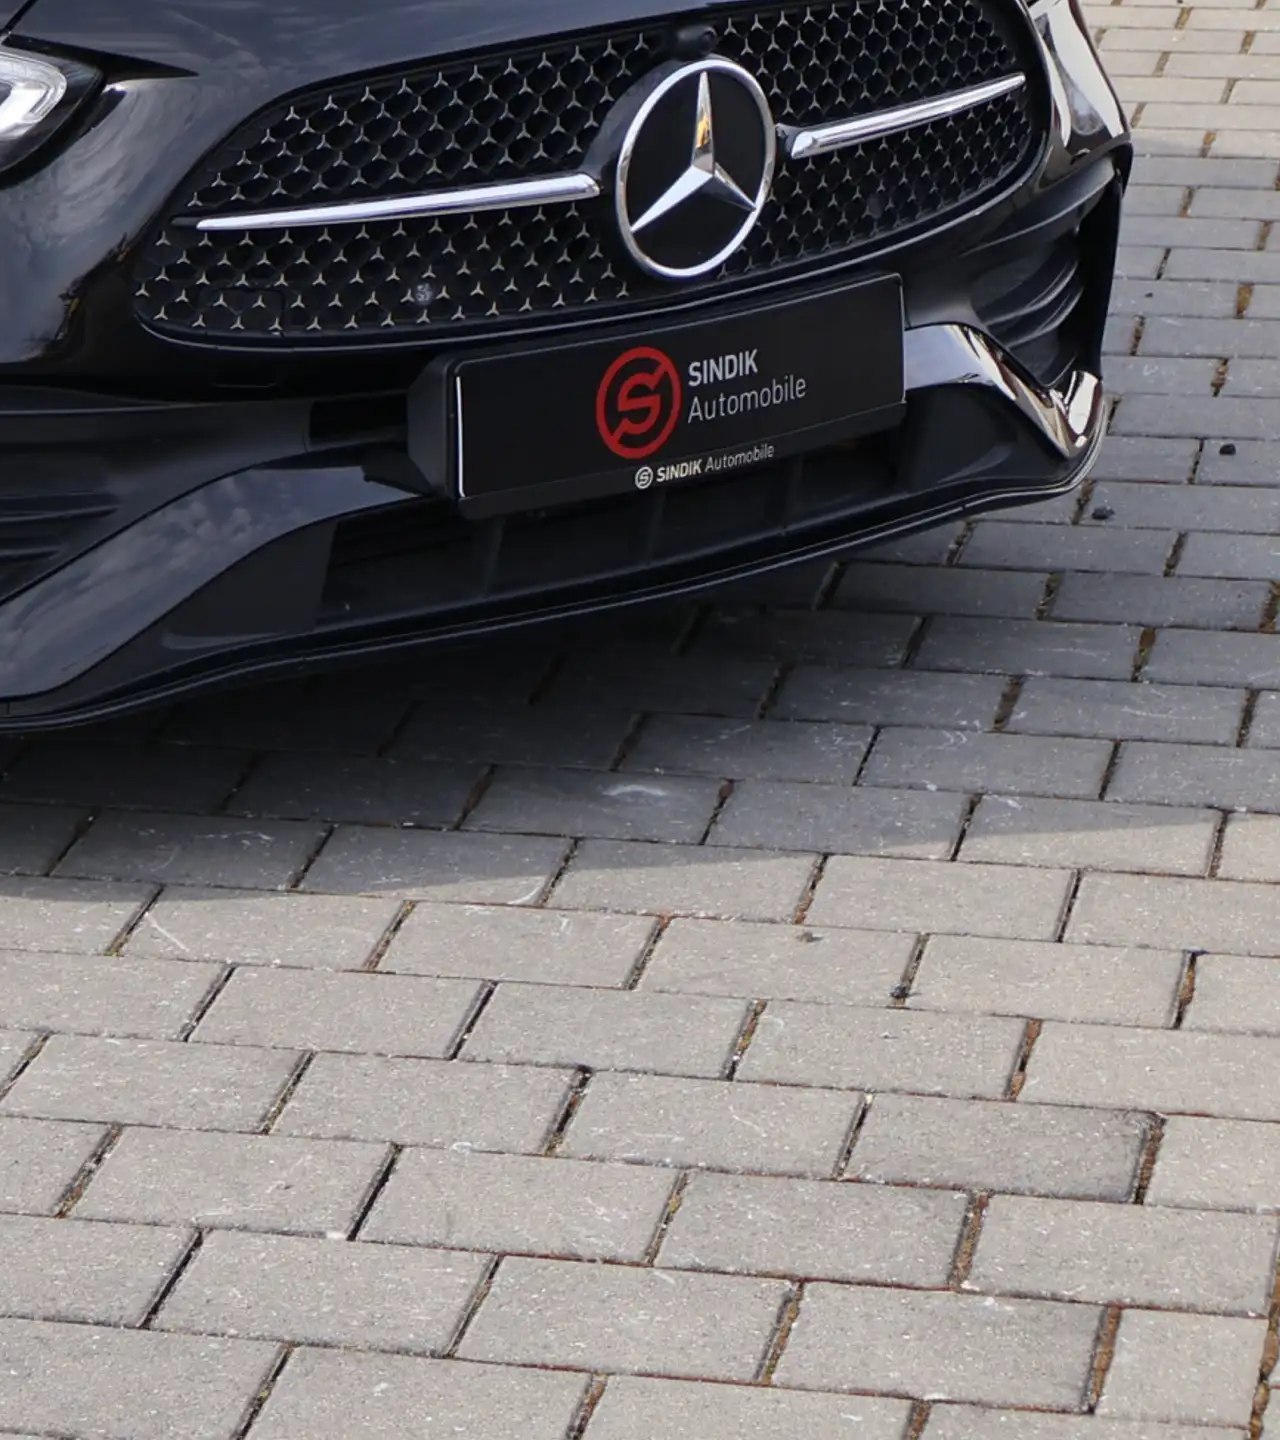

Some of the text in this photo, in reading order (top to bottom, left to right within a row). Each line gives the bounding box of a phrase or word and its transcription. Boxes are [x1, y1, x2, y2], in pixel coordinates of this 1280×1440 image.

[688, 348, 759, 388] SINDIK
[687, 373, 807, 424] Automobile
[656, 459, 702, 482] SINDIK
[704, 443, 775, 472] Automobile
